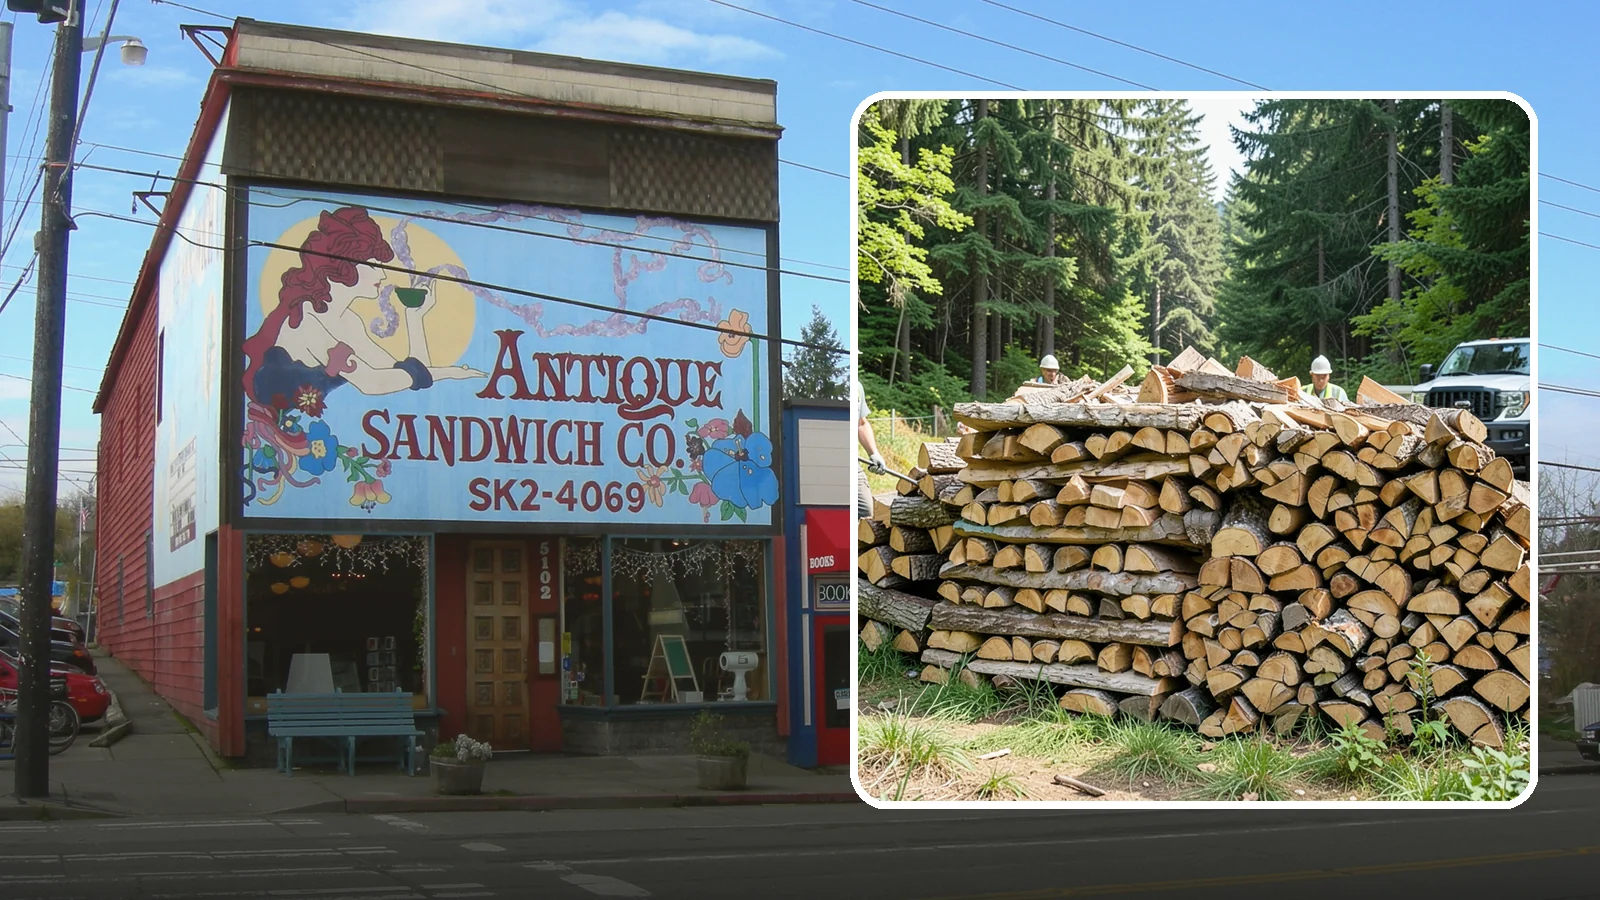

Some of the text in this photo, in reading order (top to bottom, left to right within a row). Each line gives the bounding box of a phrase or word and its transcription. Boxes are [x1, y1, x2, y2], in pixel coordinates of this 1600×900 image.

[476, 329, 723, 420] ANTIQUE
[361, 409, 685, 468] SANDWICH CO.
[468, 478, 646, 512] SK2-4069
[540, 542, 552, 600] 5102
[809, 555, 835, 569] BOOKS
